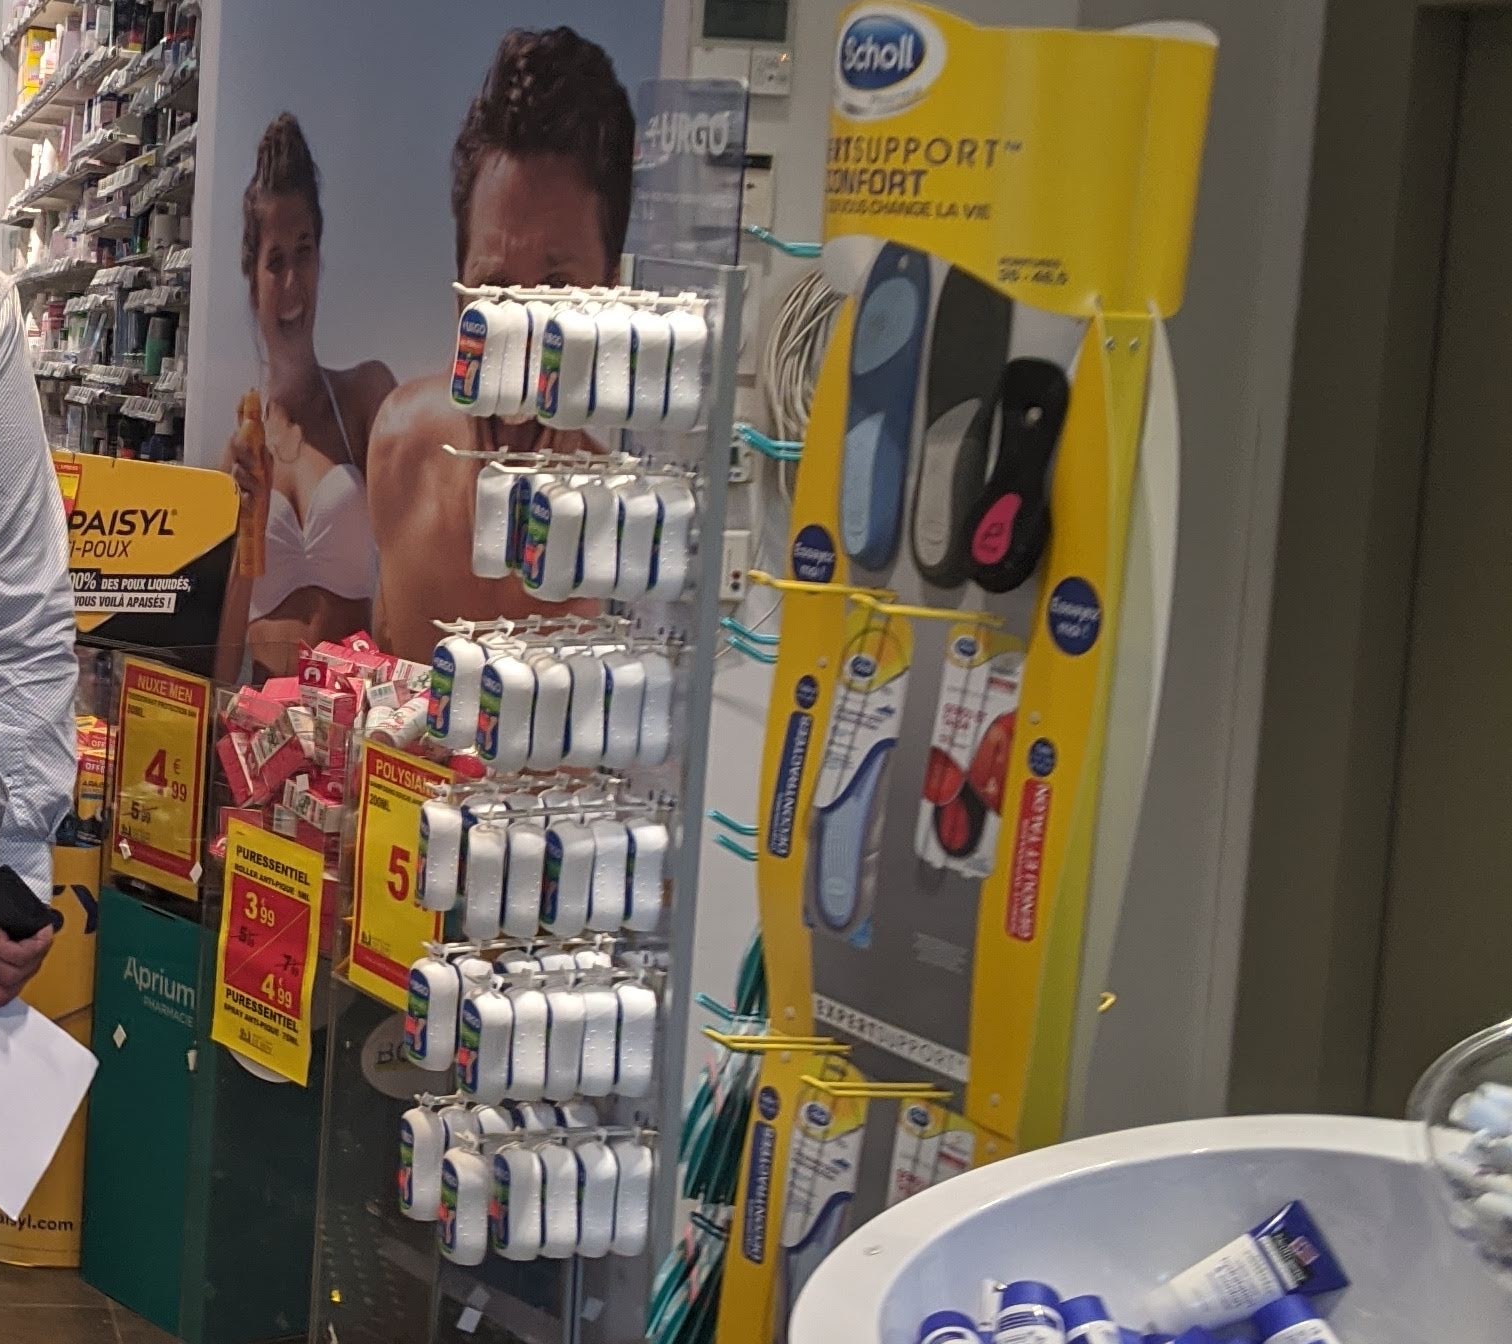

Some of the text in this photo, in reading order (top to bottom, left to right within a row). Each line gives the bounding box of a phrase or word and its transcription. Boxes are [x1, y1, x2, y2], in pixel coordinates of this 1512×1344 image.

[843, 34, 915, 72] Scholl
[935, 202, 958, 218] LA
[69, 509, 175, 536] PAISYL
[70, 540, 132, 558] I-POUX
[69, 571, 97, 590] 00%
[101, 579, 119, 590] DES
[121, 578, 147, 591] POUX
[99, 593, 125, 608] VOILÀ
[126, 594, 166, 608] APAISÉS
[138, 674, 193, 704] NUXE MEN
[145, 749, 187, 802] 4 € 99
[236, 845, 310, 886] PURESSENTIEL
[388, 844, 411, 901] 5
[245, 892, 258, 919] 3
[260, 906, 275, 927] 99
[124, 956, 195, 1010] Aprium
[261, 973, 276, 1001] 4
[277, 987, 293, 1009] 99
[143, 995, 194, 1029] PHARMACIE
[225, 988, 299, 1034] PURESSENTIEL
